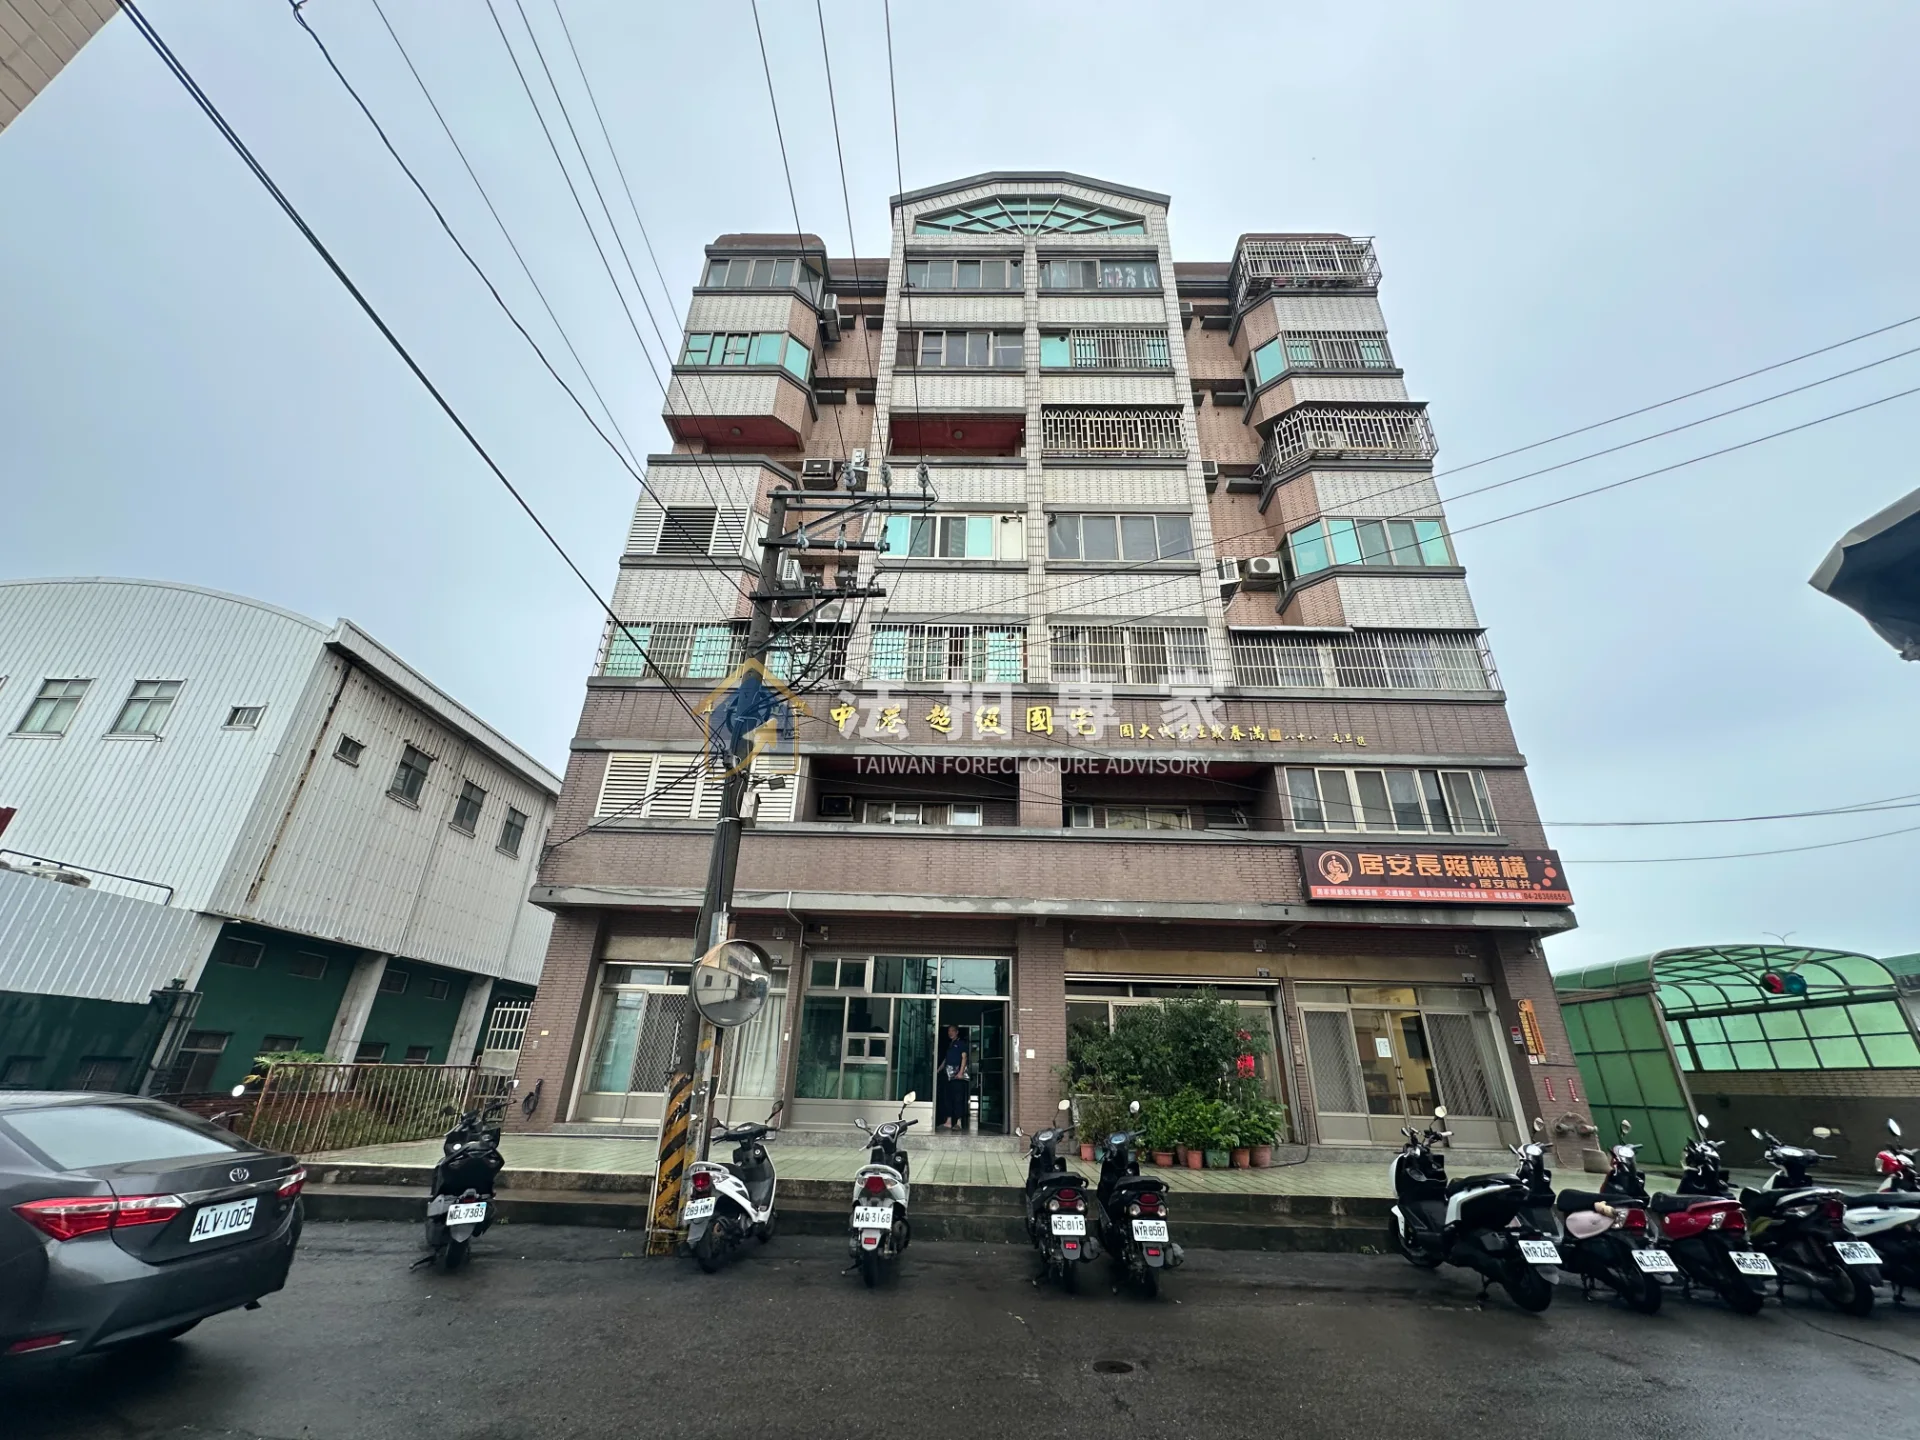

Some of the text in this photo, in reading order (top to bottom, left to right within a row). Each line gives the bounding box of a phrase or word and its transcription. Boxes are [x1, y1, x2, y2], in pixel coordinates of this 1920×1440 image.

[1357, 852, 1529, 879] 居安長照機構
[1479, 878, 1532, 890] 居安龍井
[193, 1205, 254, 1236] ALV-1005
